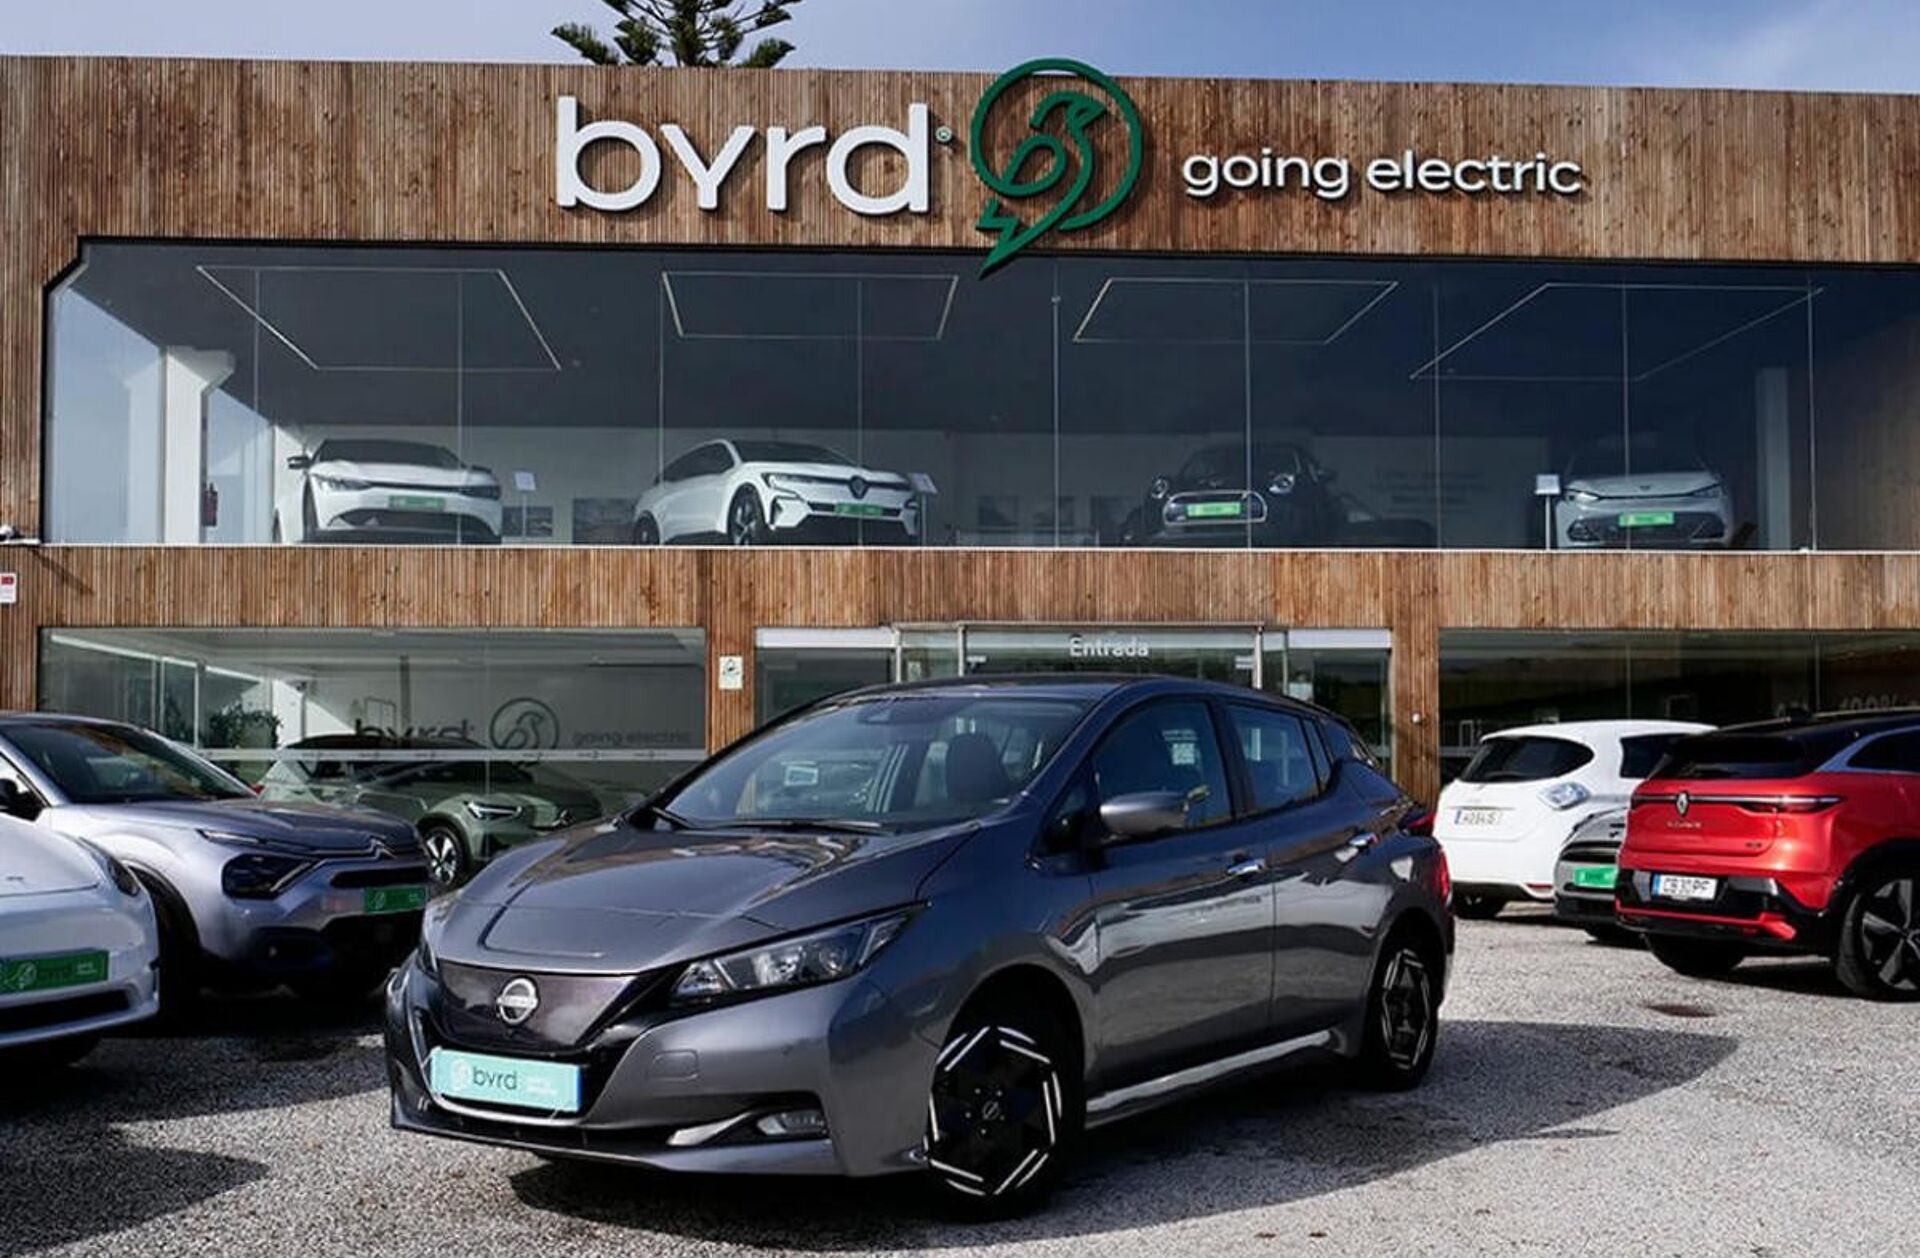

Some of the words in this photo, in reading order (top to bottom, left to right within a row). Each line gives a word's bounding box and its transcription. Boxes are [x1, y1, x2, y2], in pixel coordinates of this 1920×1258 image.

[556, 96, 929, 215] byrd
[1182, 147, 1350, 199] going
[1366, 149, 1582, 194] electric
[1069, 635, 1150, 658] Entrada
[472, 1066, 518, 1091] byrd
